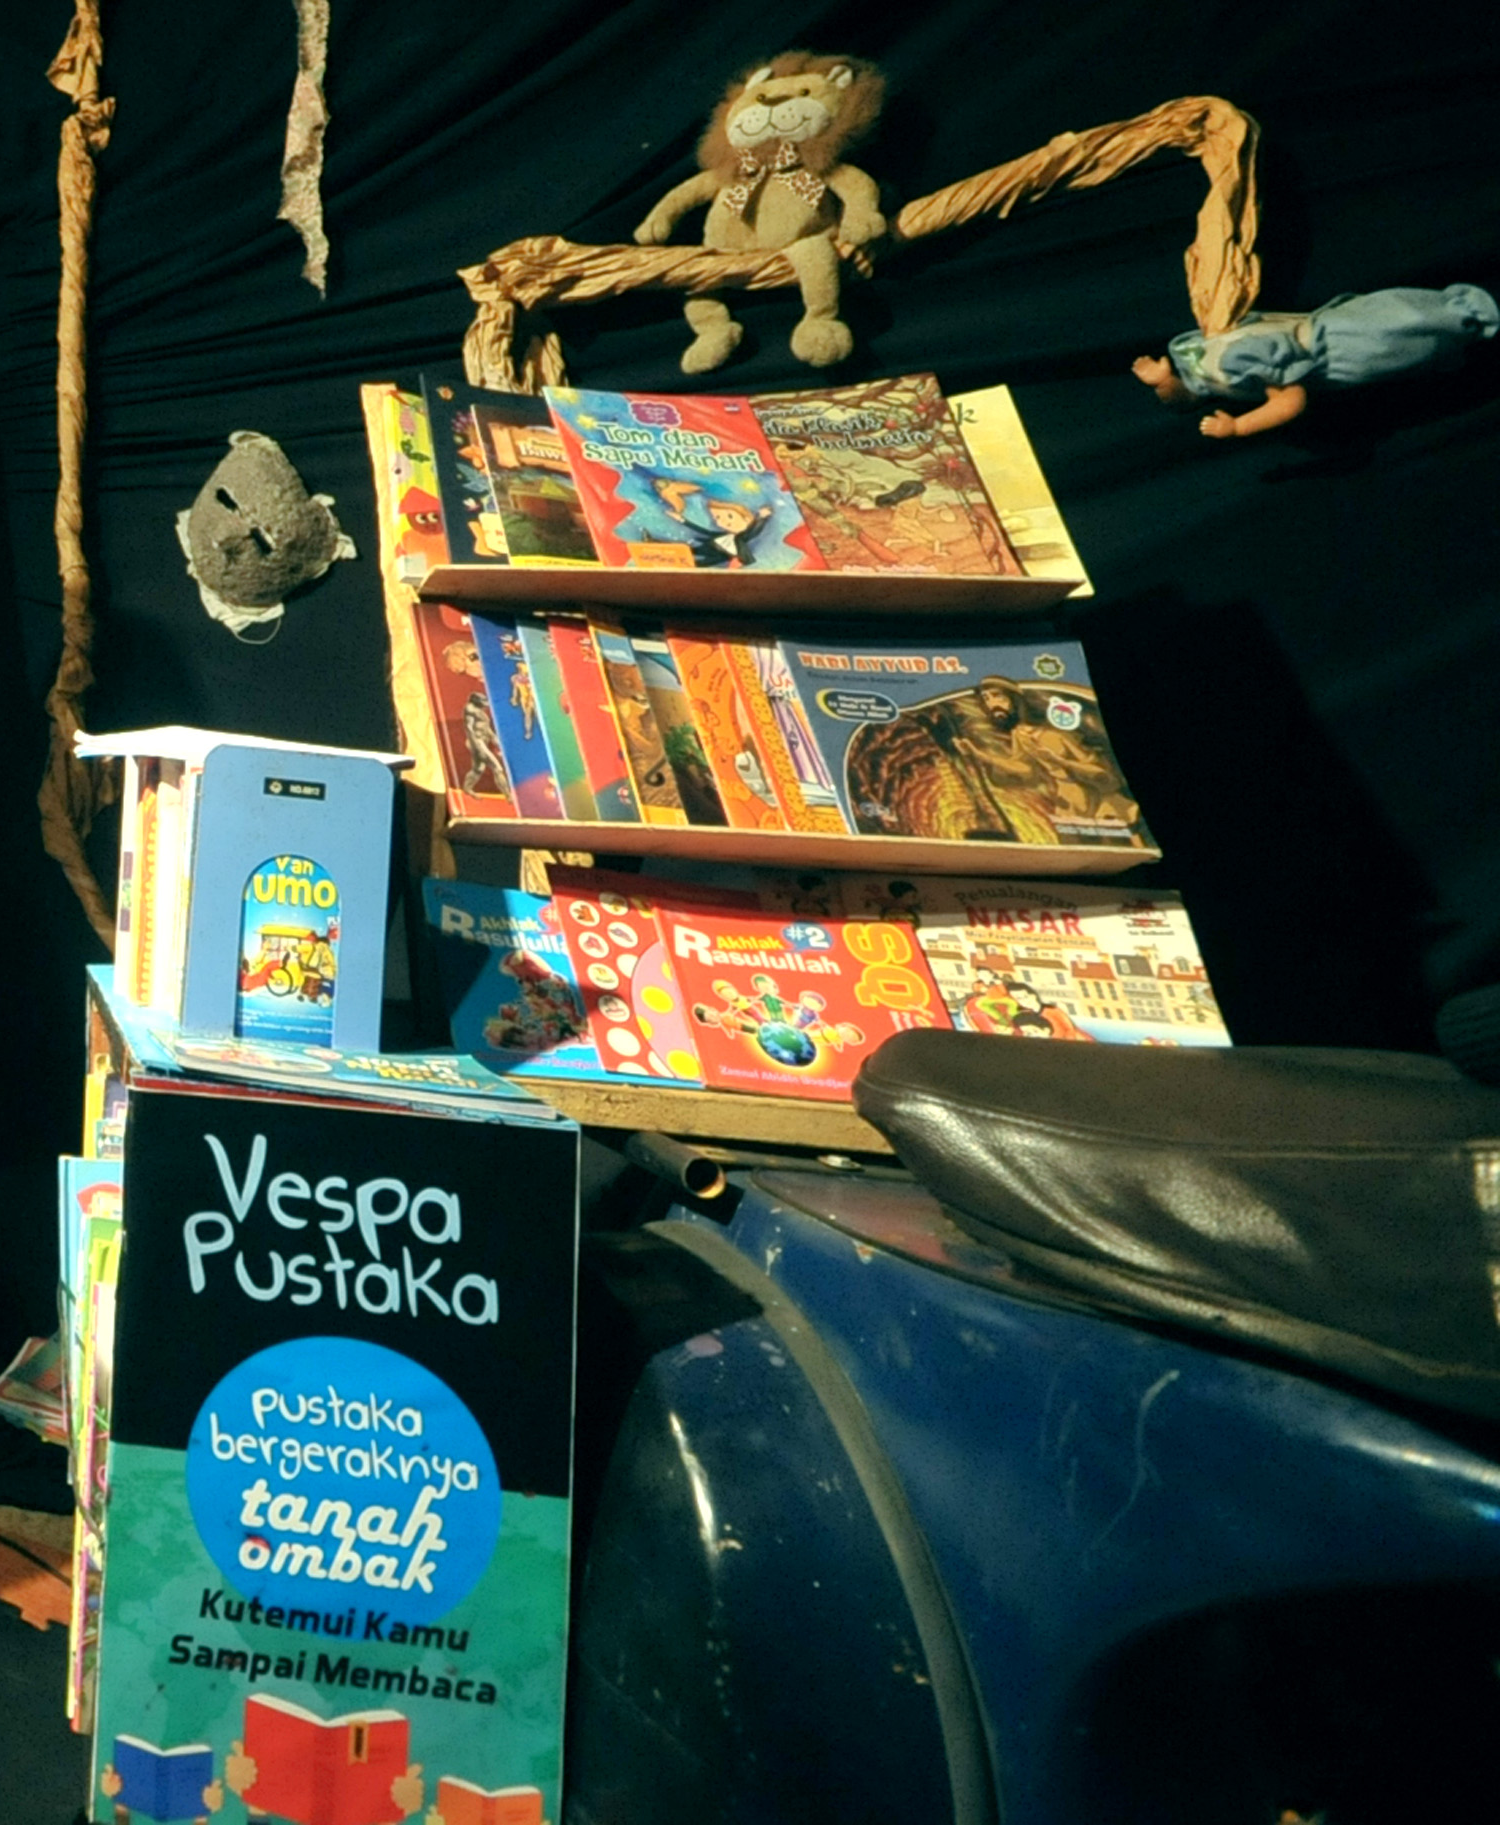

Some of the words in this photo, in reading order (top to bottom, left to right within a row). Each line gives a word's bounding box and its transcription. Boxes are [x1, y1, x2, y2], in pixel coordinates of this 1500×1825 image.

[582, 441, 655, 470] Sapu
[663, 448, 765, 472] Menari
[597, 421, 655, 444] Tom
[664, 428, 719, 450] dan
[853, 655, 929, 673] AYYUB
[480, 915, 541, 931] Akhlak
[954, 885, 1078, 912] Petualangan
[966, 905, 1085, 936] NASAR
[442, 904, 568, 953] Rasulull
[673, 924, 842, 976] Rasulullah
[716, 936, 785, 951] Akhlak
[786, 923, 830, 949] #2
[203, 1132, 462, 1261] Vespa
[182, 1211, 499, 1326] Pustaka
[251, 1384, 424, 1438] pustaka
[210, 1412, 480, 1499] bergeraknya
[239, 1478, 448, 1552] tanah
[238, 1531, 437, 1594] ombak
[200, 1588, 356, 1638] Kutemui
[362, 1611, 471, 1653] Kamu
[168, 1633, 305, 1683] Sampai
[313, 1653, 498, 1706] Membaca
